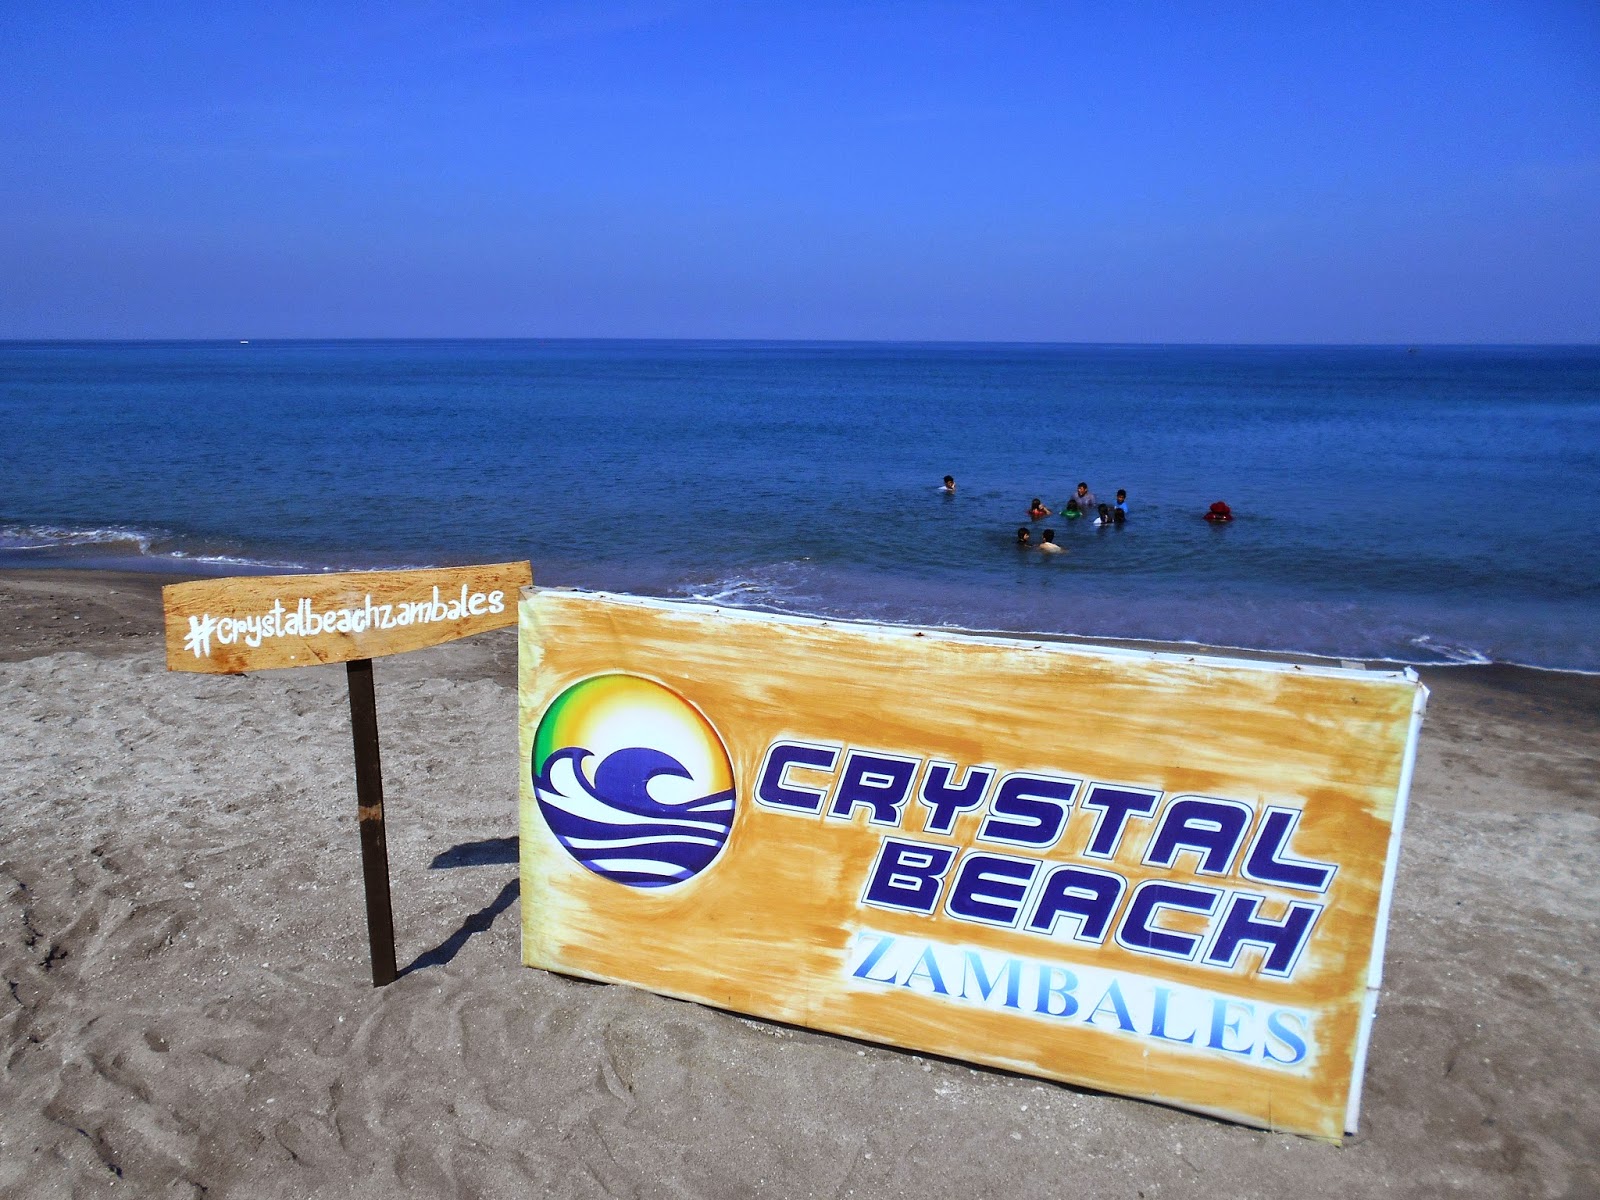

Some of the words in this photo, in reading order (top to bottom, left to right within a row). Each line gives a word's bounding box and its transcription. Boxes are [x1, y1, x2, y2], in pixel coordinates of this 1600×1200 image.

[183, 584, 505, 658] #crystalbeachzambales
[753, 739, 1338, 894] CRYSTAL
[861, 835, 1324, 979] BEACH
[851, 931, 1308, 1065] ZAMBALES
